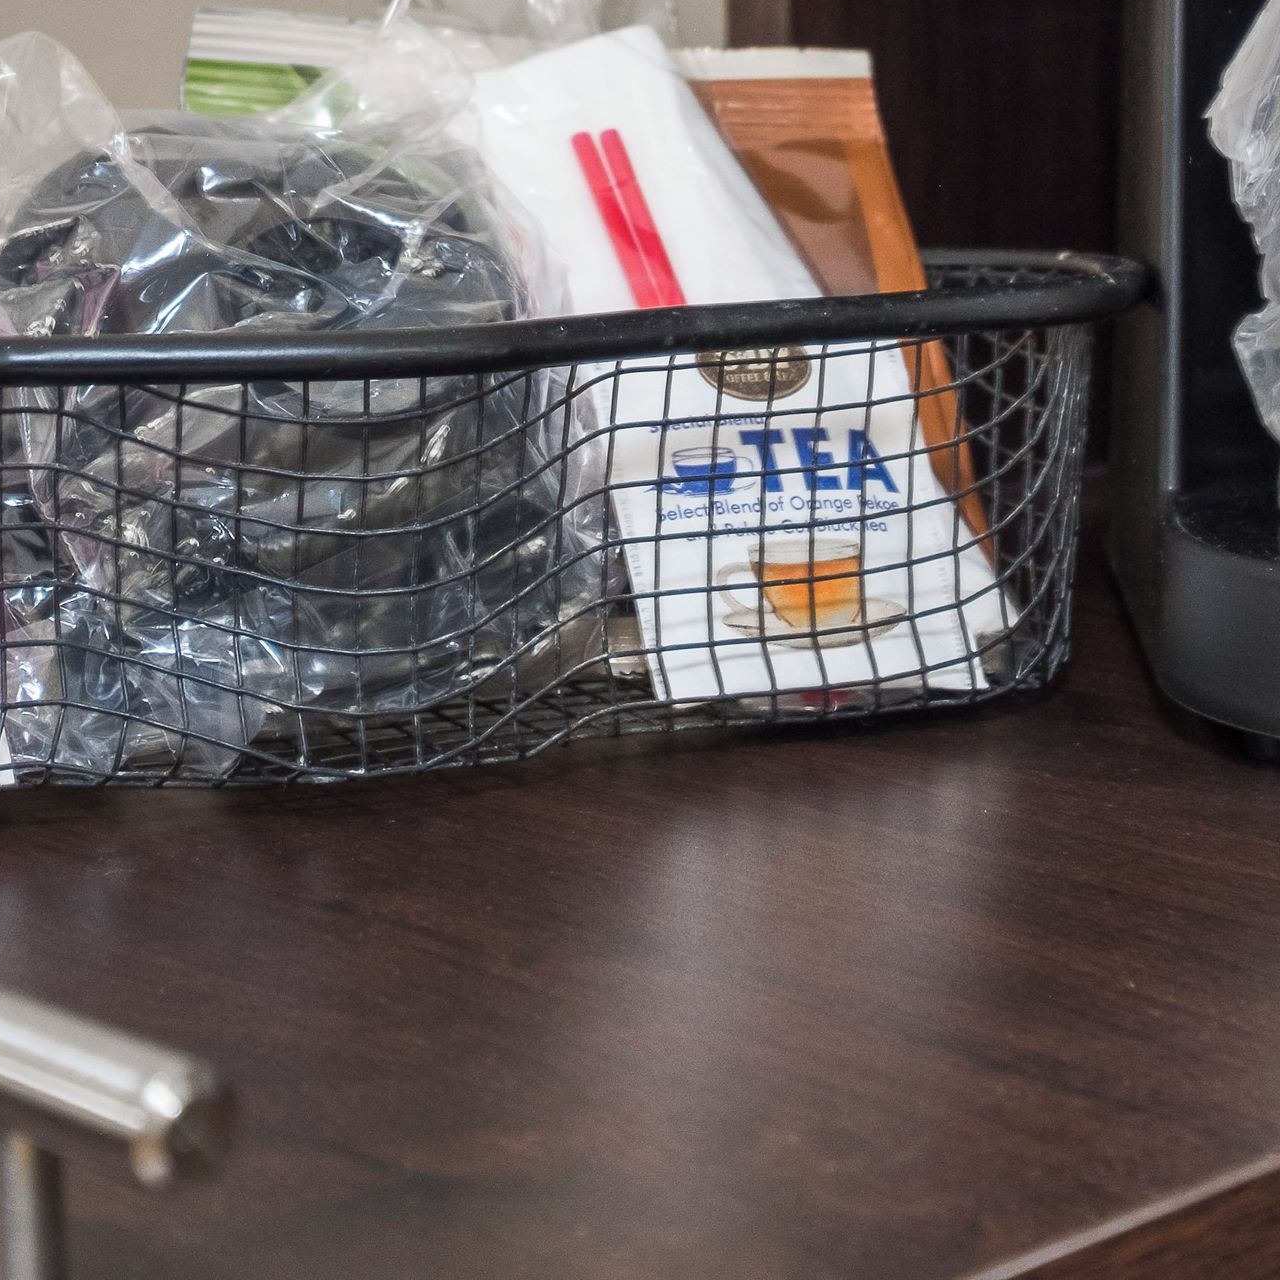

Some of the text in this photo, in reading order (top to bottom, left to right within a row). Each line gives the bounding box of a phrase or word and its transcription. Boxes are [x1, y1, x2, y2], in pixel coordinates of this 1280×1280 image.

[739, 427, 900, 493] TEA
[714, 498, 762, 515] Blend
[768, 496, 784, 512] of
[790, 495, 852, 512] Orange
